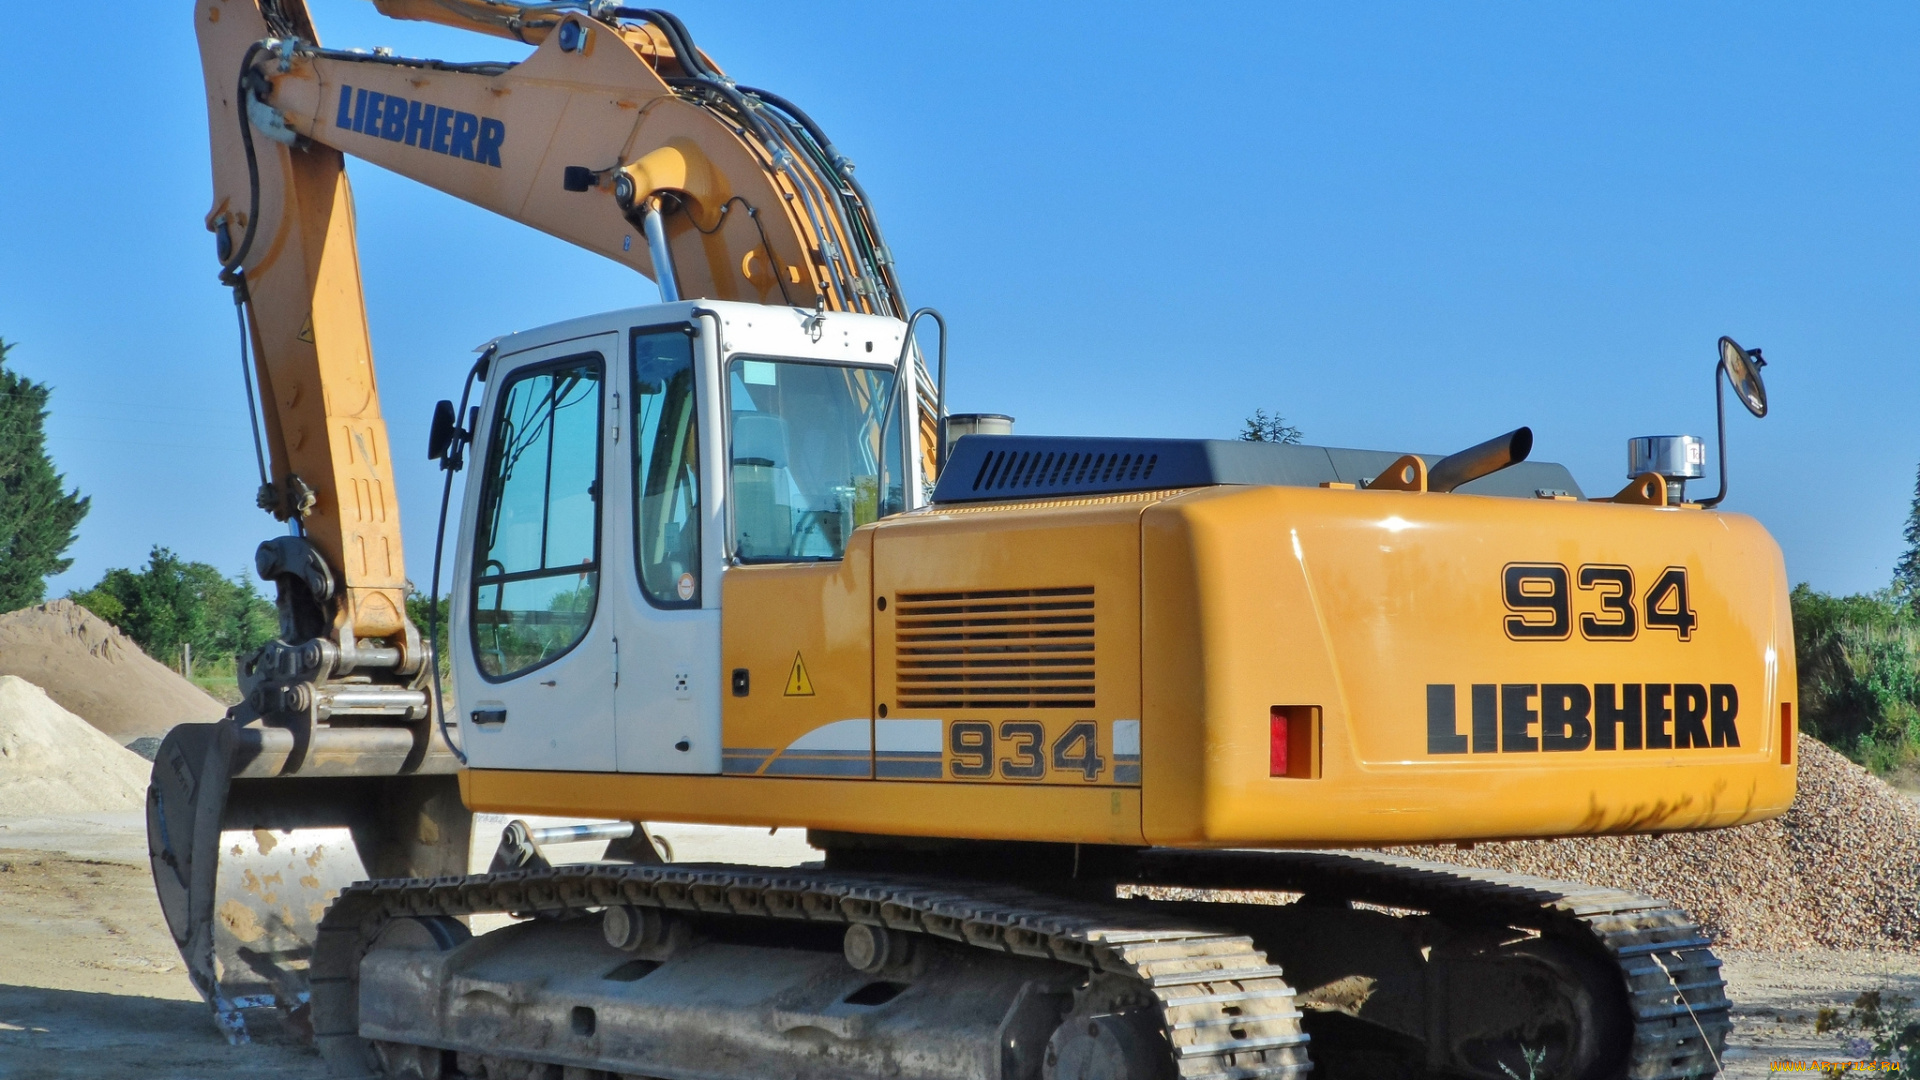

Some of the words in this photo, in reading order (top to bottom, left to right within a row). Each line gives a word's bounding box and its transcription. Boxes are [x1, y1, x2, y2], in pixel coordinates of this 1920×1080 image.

[336, 84, 505, 168] LIEBHERR
[1501, 561, 1697, 642] 934
[949, 720, 1105, 782] 934
[1426, 684, 1741, 754] LIEBHERR
